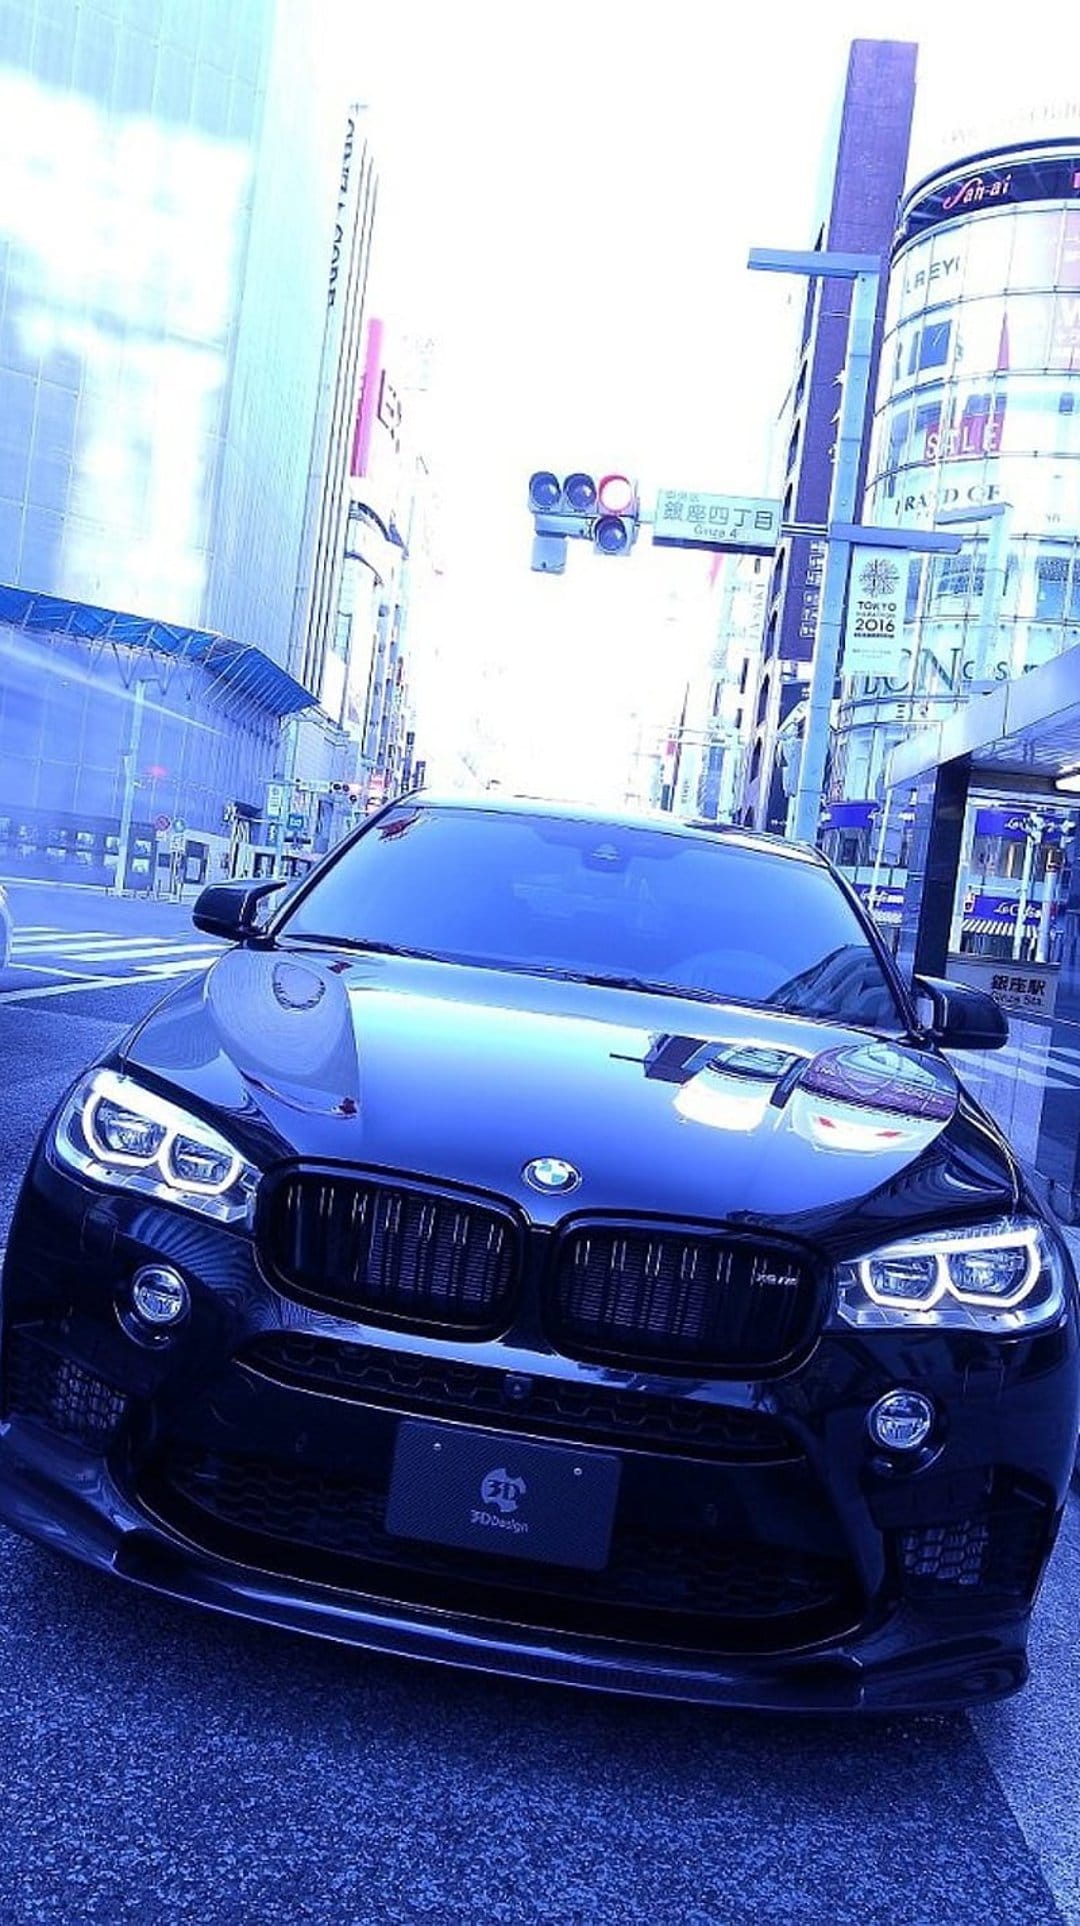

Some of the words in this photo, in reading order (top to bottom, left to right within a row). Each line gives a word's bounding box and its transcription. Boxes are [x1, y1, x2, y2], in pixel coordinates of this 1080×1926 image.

[942, 174, 1013, 210] San-ai
[925, 421, 1000, 460] SALE
[663, 500, 774, 532] 銀座四丁目
[693, 523, 726, 538] Ginza
[728, 528, 738, 538] 4
[856, 600, 897, 613] TOKYO
[854, 618, 896, 633] 2016
[991, 974, 1047, 996] 銀座駅
[486, 1479, 521, 1501] 3D
